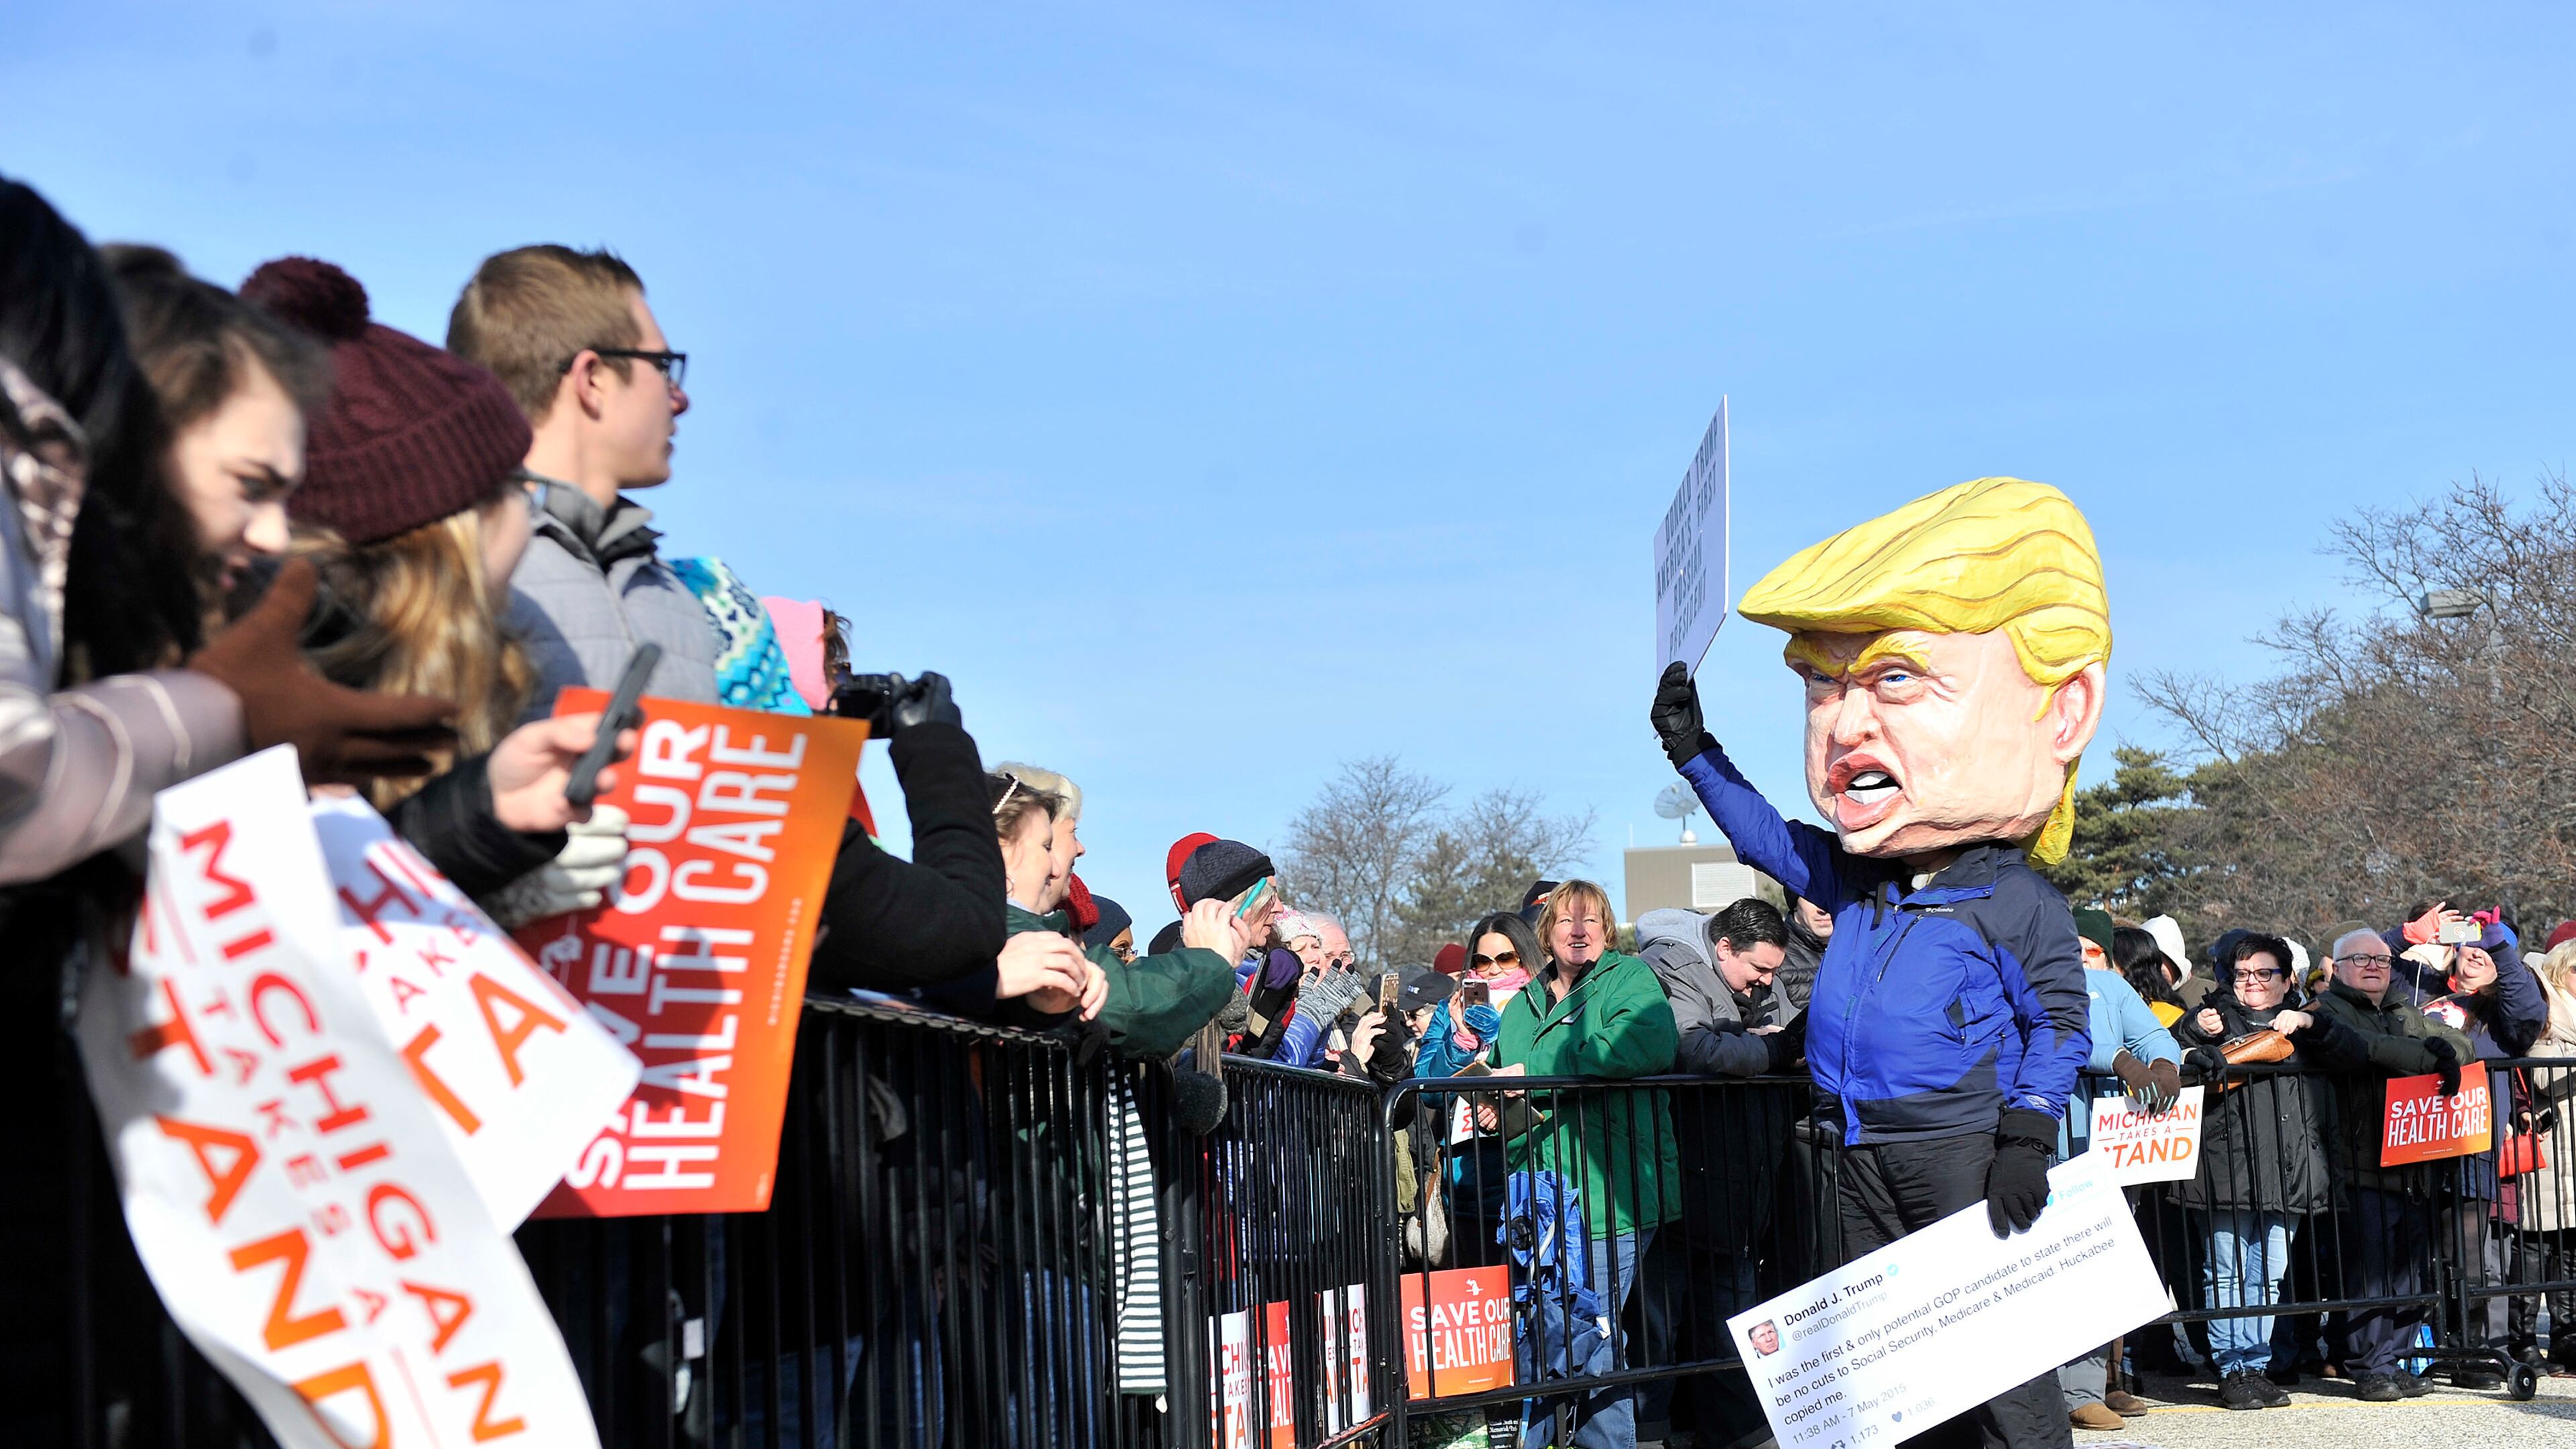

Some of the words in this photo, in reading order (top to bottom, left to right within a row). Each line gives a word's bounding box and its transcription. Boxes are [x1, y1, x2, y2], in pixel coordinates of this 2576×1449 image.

[1665, 470, 1692, 546] DONALD
[1695, 415, 1717, 486] TRUMP
[1657, 514, 1692, 604] AMERICA'S
[1697, 461, 1716, 527] FIRST
[1673, 533, 1703, 616] RUSSIAN
[1669, 567, 1707, 663] PRESIDENT
[606, 719, 711, 914] OUR
[672, 724, 808, 904] CARE
[622, 925, 754, 1191] HEALTH
[181, 820, 527, 1444] MICHIGAN
[2387, 1112, 2448, 1148] HEALTH
[2451, 1104, 2488, 1139] CARE
[2390, 1095, 2445, 1119] SAVE
[2450, 1086, 2488, 1110] OUR
[201, 985, 352, 1237] TAKES
[351, 1286, 390, 1326] A
[2104, 1136, 2194, 1169] TAND
[2120, 1127, 2157, 1141] TAKES
[2164, 1126, 2171, 1134] A
[2059, 1180, 2094, 1200] Follow
[1410, 1301, 1481, 1331] SAVE
[1485, 1297, 1511, 1323] OUR
[1768, 1378, 1774, 1388] I
[1775, 1367, 1799, 1385] was
[1801, 1356, 1820, 1373] the
[1821, 1345, 1844, 1363] first
[1845, 1340, 1856, 1352] &
[1858, 1328, 1881, 1346] only
[1884, 1302, 1932, 1335] potential
[1933, 1287, 1961, 1309] GOP
[1964, 1263, 2019, 1295] candidate
[2020, 1256, 2032, 1267] to
[2034, 1242, 2061, 1261] state
[2063, 1228, 2092, 1246] there
[2094, 1216, 2112, 1232] will
[1775, 1391, 1792, 1407] be
[1794, 1385, 1809, 1399] no
[1811, 1372, 1835, 1390] cuts
[1837, 1365, 1849, 1377] to
[1851, 1346, 1886, 1371] Social
[1939, 1298, 1990, 1328] Medicare
[1993, 1291, 2002, 1302] &
[2004, 1266, 2057, 1297] Medicaid.
[2059, 1238, 2115, 1270] Huckabee
[1784, 1297, 1828, 1326] Donald
[1831, 1293, 1842, 1305] J.
[1843, 1274, 1883, 1298] Trump
[1792, 1291, 1888, 1342] @realDonaldTrump
[1411, 1326, 1488, 1373] HEALTH
[1489, 1322, 1511, 1363] CARE
[1784, 1399, 1823, 1428] copied
[1825, 1391, 1847, 1407] me.
[1793, 1425, 1821, 1444] 11:38
[1823, 1415, 1840, 1430] AM
[1847, 1407, 1854, 1417] 7
[1857, 1397, 1879, 1413] May
[1880, 1383, 1907, 1402] 2015
[1850, 1425, 1879, 1444] 1,173
